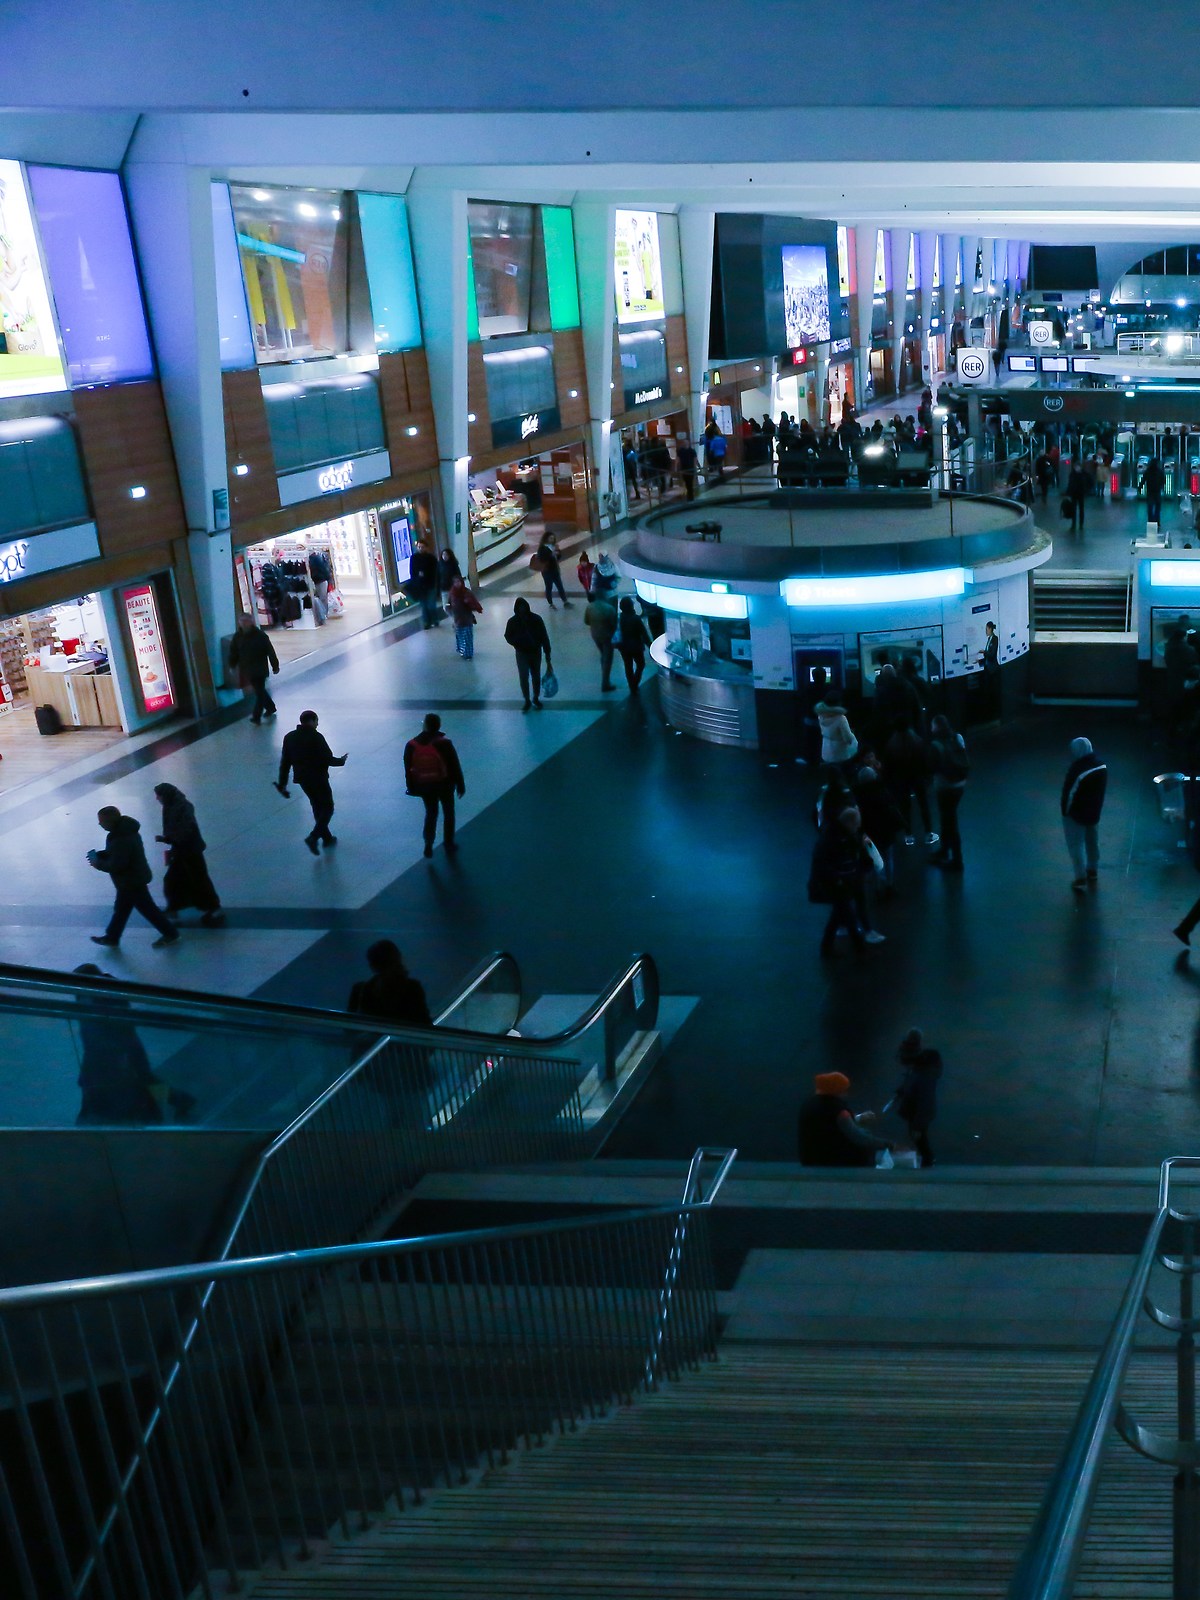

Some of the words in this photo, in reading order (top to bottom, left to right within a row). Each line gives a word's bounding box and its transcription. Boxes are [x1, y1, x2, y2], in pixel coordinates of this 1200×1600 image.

[1034, 330, 1048, 338] RER
[18, 341, 37, 351] Glovo
[963, 361, 983, 372] RER
[634, 386, 663, 405] McDonald's
[1046, 398, 1061, 407] RER
[138, 643, 157, 655] MODE
